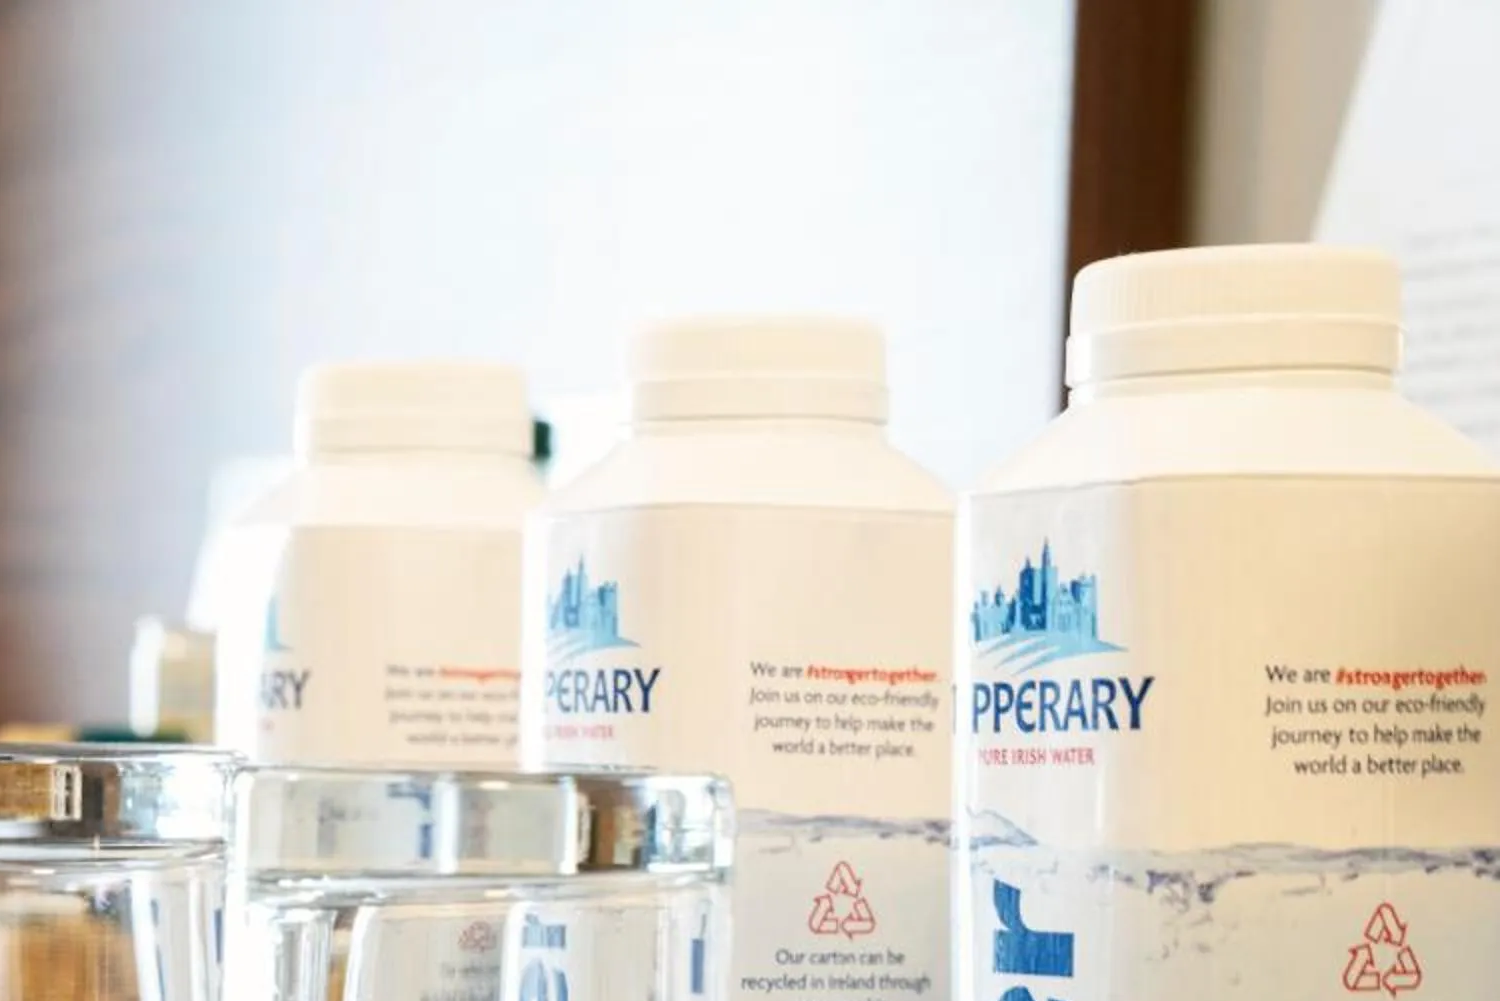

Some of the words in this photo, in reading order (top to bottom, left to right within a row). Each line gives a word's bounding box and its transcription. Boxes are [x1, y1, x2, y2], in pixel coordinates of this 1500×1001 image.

[750, 662, 777, 677] We
[781, 665, 803, 678] are
[1265, 665, 1297, 683] We
[1303, 668, 1330, 684] are
[1335, 664, 1487, 690] #strongertogether
[749, 688, 780, 705] Join
[784, 691, 800, 703] us
[804, 691, 823, 703] on
[827, 692, 847, 704] our
[851, 690, 939, 711] eco-friendly
[972, 676, 1155, 734] PPERARY
[1265, 696, 1301, 716] Join
[1308, 701, 1328, 714] us
[1333, 701, 1356, 714] on
[1362, 700, 1390, 714] our
[1396, 692, 1486, 719] eco-friendly
[753, 714, 811, 731] journey
[815, 716, 830, 729] to
[835, 713, 862, 734] help
[866, 716, 907, 731] make
[911, 717, 934, 732] the
[772, 739, 814, 754] world
[818, 744, 825, 754] a
[830, 740, 871, 755] better
[1271, 725, 1342, 749] journey
[1349, 729, 1369, 743] to
[1374, 724, 1408, 748] help
[1412, 723, 1452, 743] make
[1457, 724, 1482, 743] the
[1012, 748, 1046, 765] IRISH
[1051, 747, 1095, 765] WATER
[1294, 755, 1346, 774] world
[1352, 761, 1361, 774] a
[1367, 754, 1417, 774] better
[1421, 753, 1465, 778] place.
[775, 948, 805, 964] Our
[809, 952, 855, 965] carton
[859, 952, 883, 965] can
[887, 949, 905, 964] be
[741, 974, 806, 993] recycled
[811, 975, 825, 989] in
[880, 974, 931, 995] through
